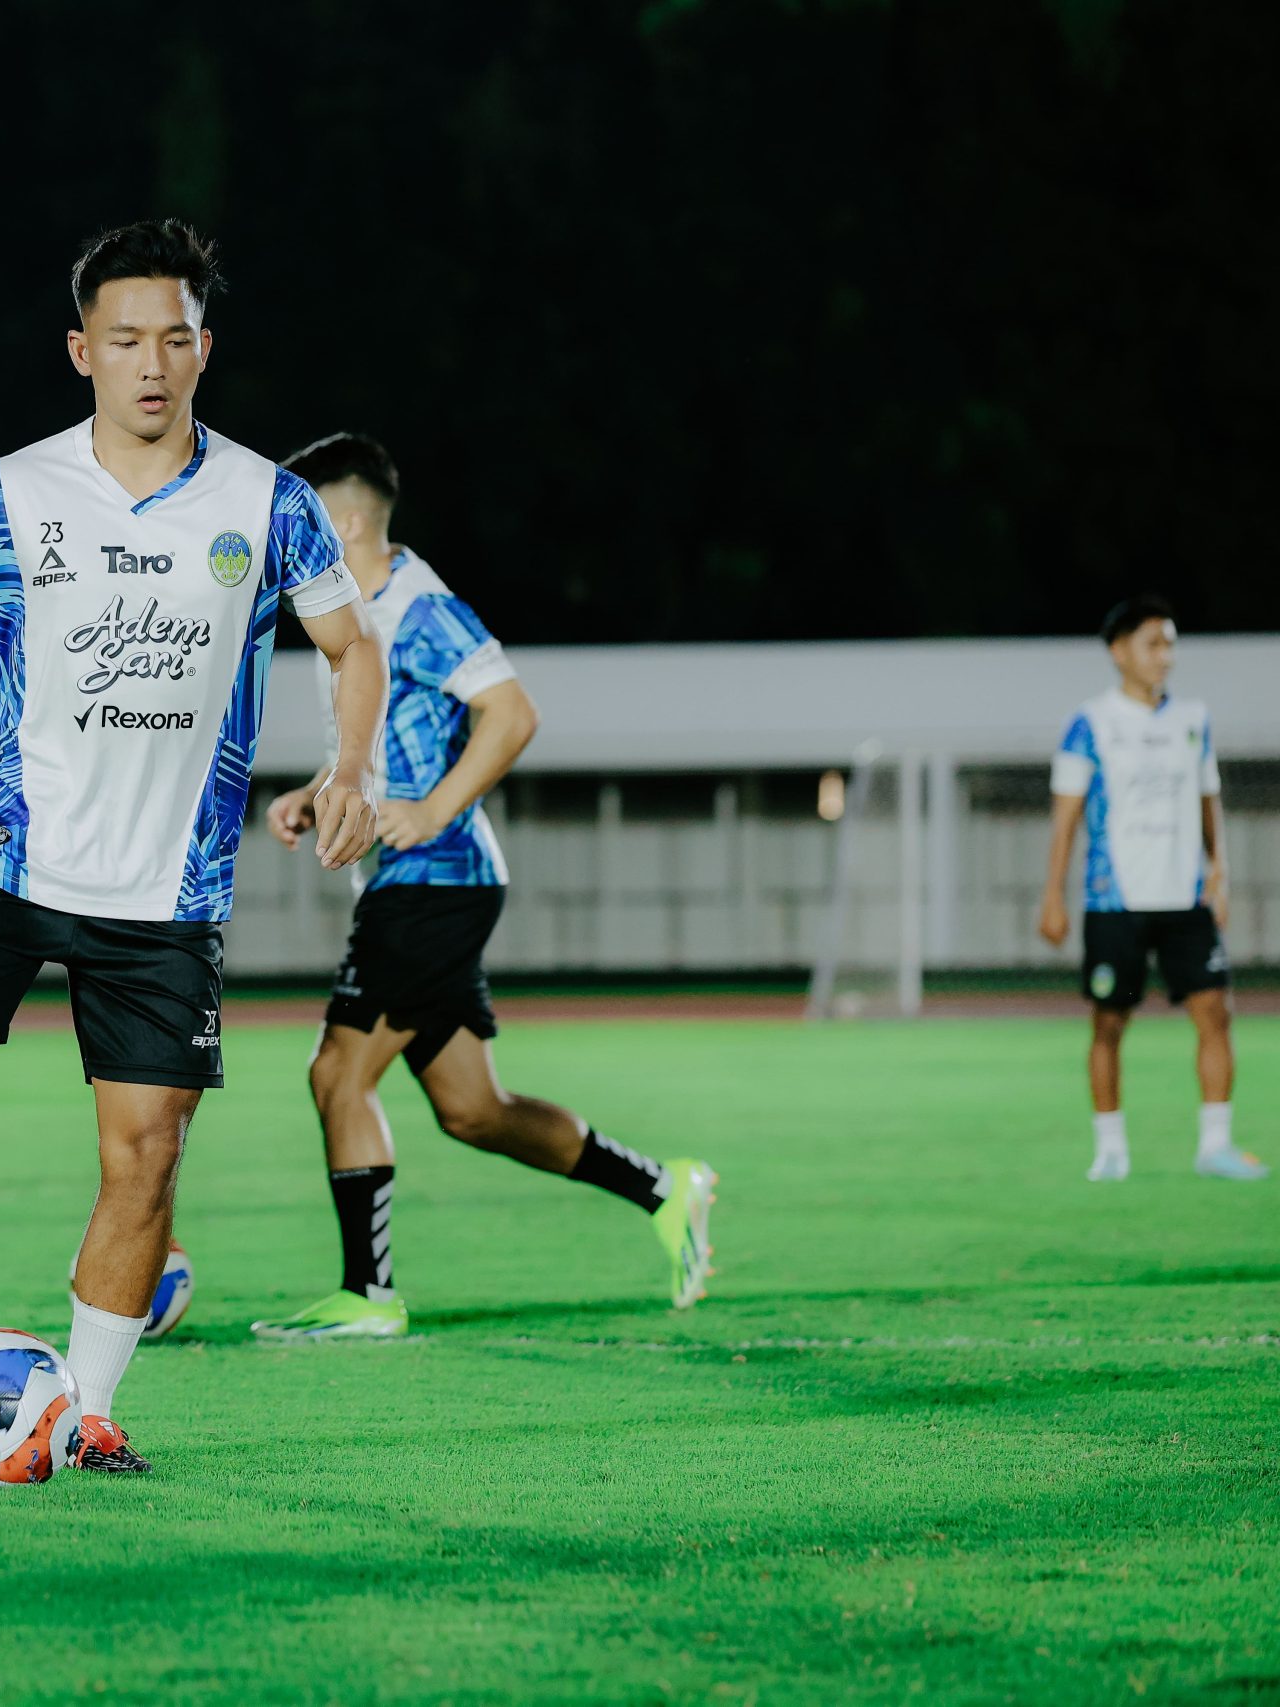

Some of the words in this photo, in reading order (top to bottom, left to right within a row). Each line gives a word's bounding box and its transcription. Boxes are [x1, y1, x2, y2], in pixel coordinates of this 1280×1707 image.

[40, 521, 64, 544] 23
[101, 546, 173, 574] Taro
[32, 571, 78, 588] apex
[64, 594, 211, 653] Adem
[77, 638, 192, 694] Sari
[101, 705, 195, 730] Rexona
[204, 1010, 218, 1034] 23
[191, 1035, 220, 1049] apex
